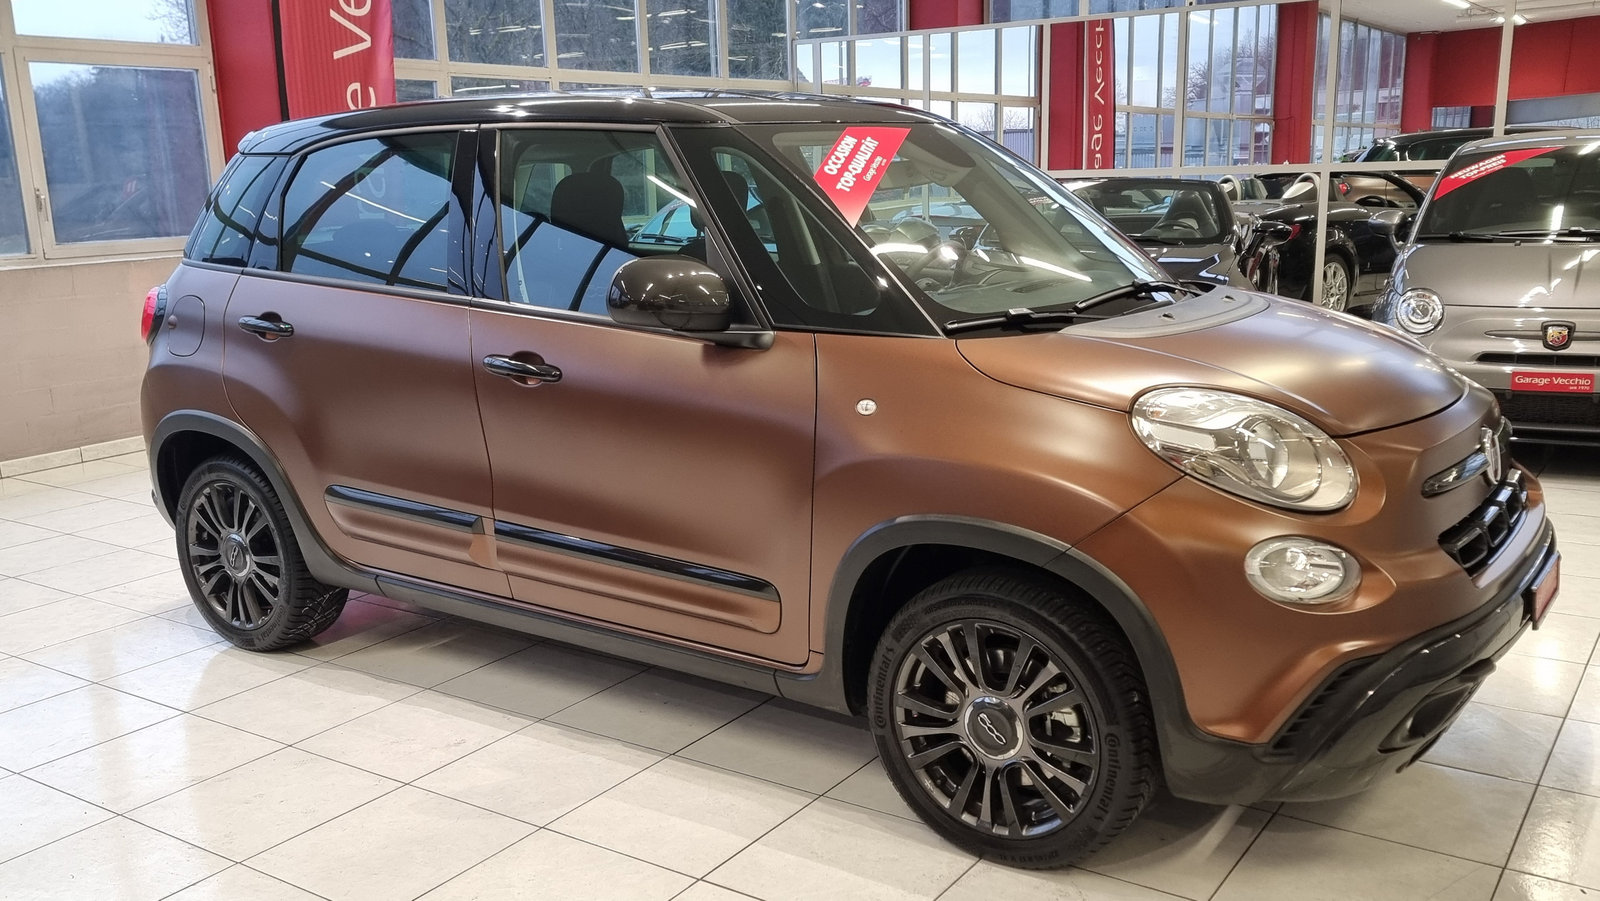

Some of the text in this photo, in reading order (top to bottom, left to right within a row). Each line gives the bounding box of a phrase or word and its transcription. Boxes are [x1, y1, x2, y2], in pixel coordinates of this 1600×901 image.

[823, 134, 858, 175] OCCASION
[835, 136, 880, 192] TOP-QUALITÄT
[1449, 154, 1506, 179] NEUWAGEN
[1458, 158, 1507, 179] TOP-PREIS
[1515, 375, 1591, 386] Garage Vecchio
[872, 656, 892, 730] Continental
[1099, 732, 1122, 815] Continental
